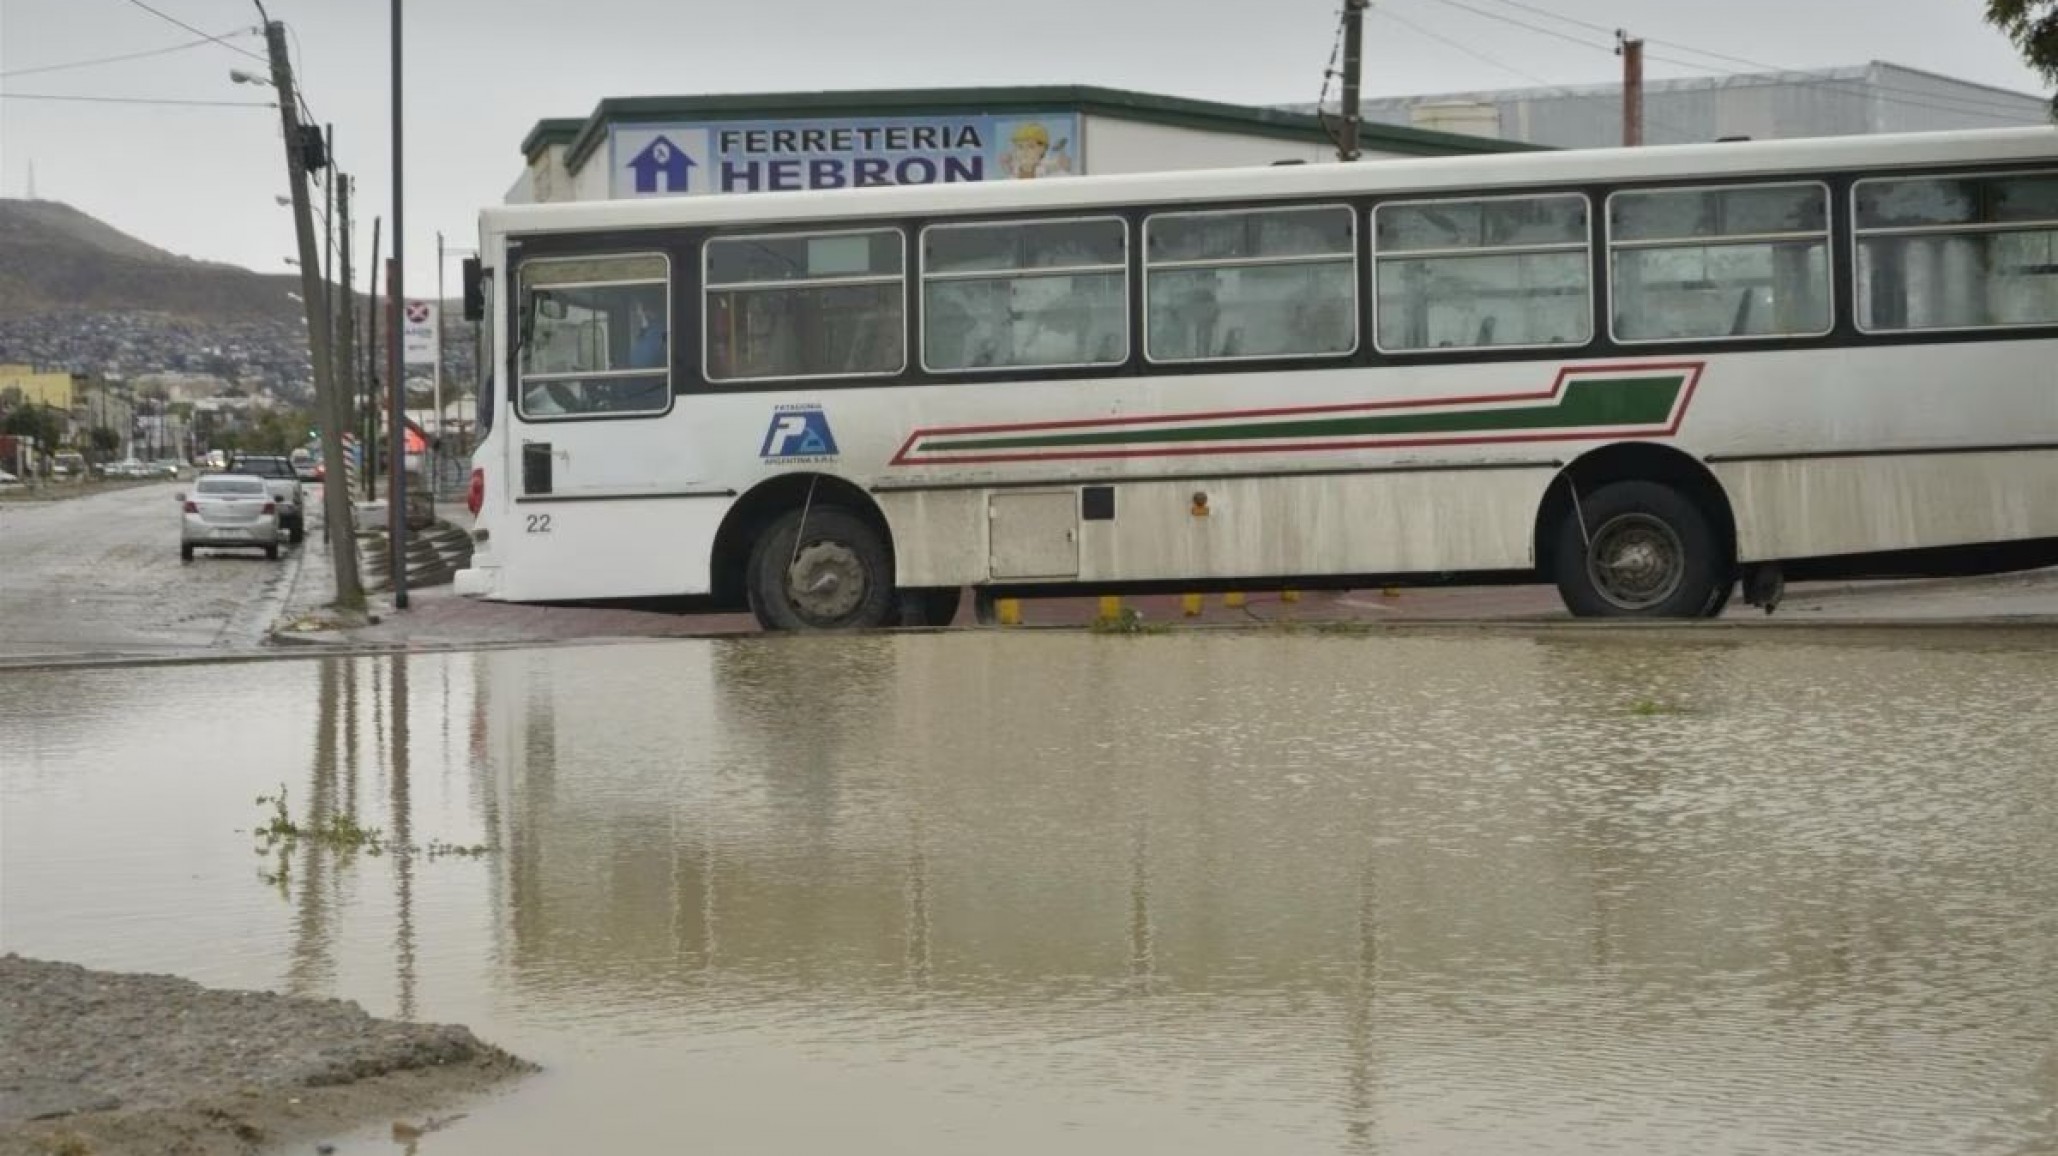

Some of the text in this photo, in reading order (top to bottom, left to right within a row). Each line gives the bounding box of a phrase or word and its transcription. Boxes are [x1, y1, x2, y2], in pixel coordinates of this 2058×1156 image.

[721, 125, 982, 153] FERRETERIA
[721, 156, 983, 192] HEBRON
[527, 514, 551, 533] 22
